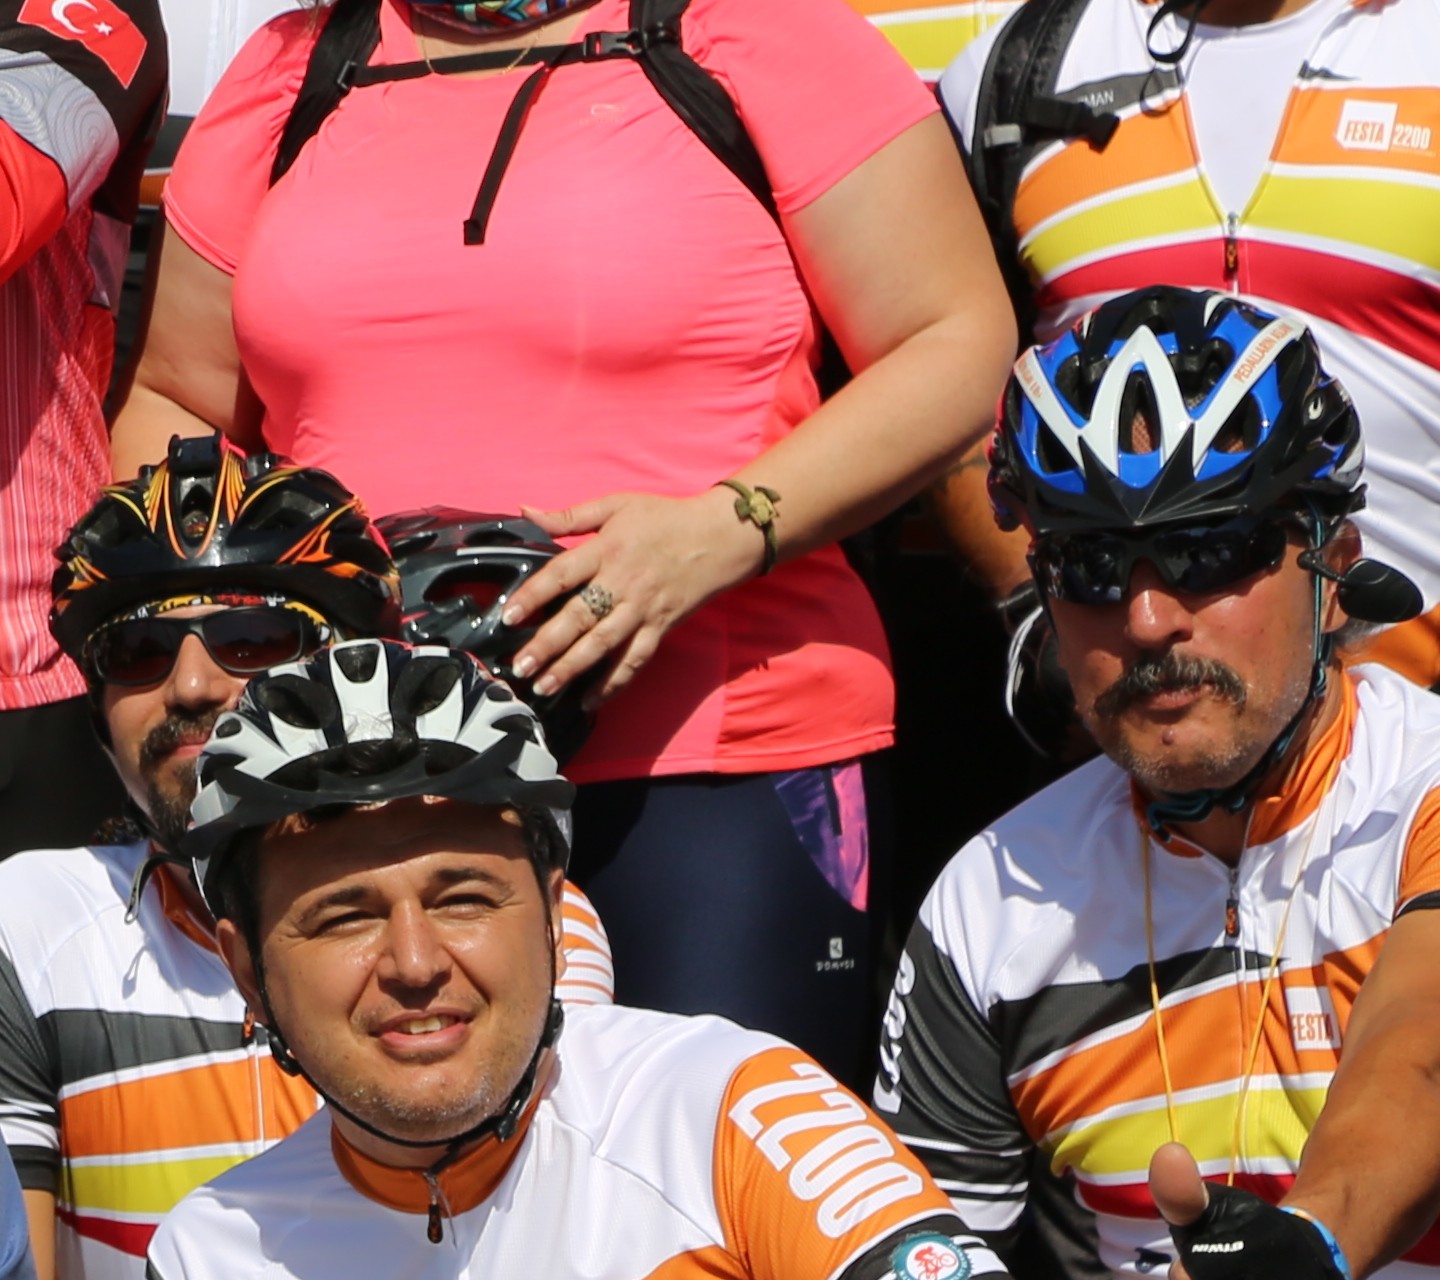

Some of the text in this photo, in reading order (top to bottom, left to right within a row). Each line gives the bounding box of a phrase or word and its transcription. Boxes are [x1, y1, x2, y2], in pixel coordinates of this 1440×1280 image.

[1344, 120, 1433, 150] FESTA 2200
[728, 1061, 925, 1240] 2200
